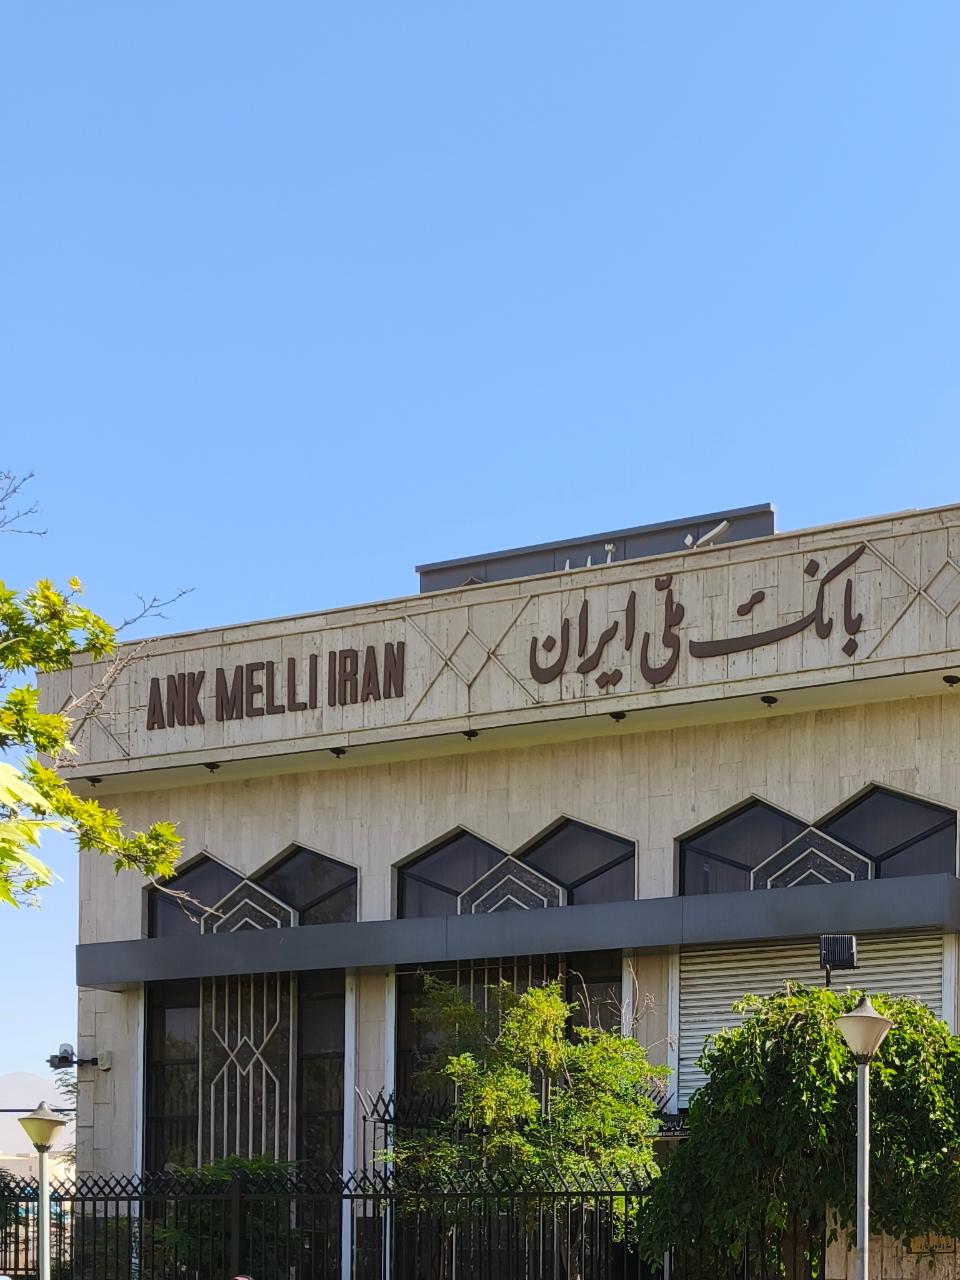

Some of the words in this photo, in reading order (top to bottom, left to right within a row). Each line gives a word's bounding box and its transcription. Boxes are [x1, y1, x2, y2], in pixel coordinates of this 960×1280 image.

[530, 590, 637, 690] ایران
[689, 545, 866, 658] بانک
[146, 670, 206, 731] ANK
[215, 653, 318, 722] MELLI
[327, 641, 406, 707] IRAN
